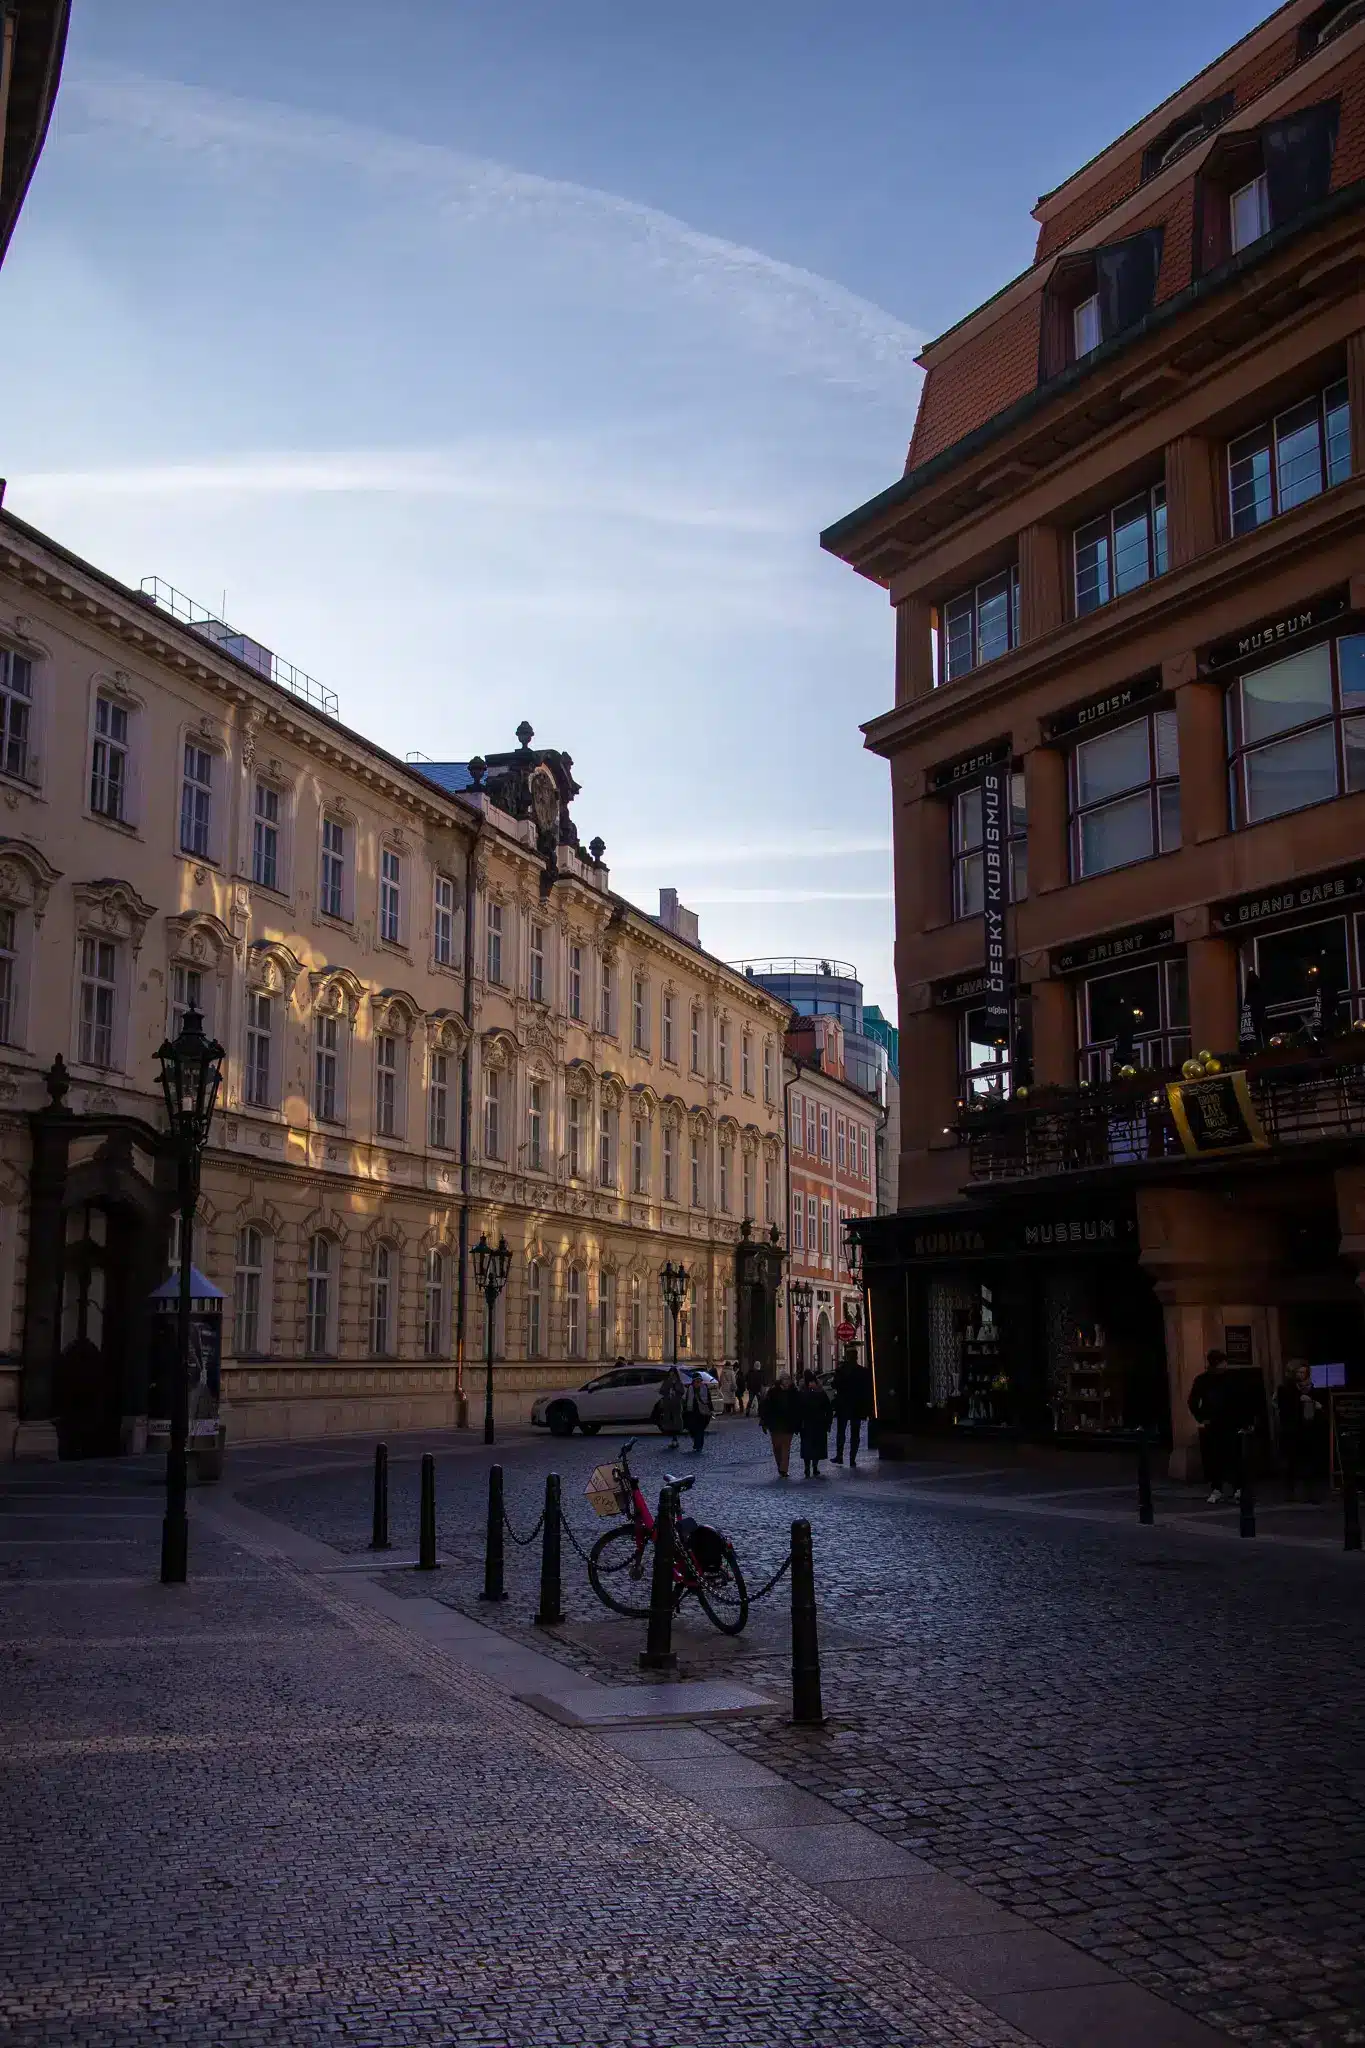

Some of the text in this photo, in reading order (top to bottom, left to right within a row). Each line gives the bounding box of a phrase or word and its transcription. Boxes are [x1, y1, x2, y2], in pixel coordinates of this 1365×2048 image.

[1238, 611, 1313, 655] MUSEUM
[1077, 690, 1132, 724] CUBISM
[952, 751, 994, 778] CZECH
[985, 775, 1004, 993] ČESKÝ KUBISMUS
[1238, 879, 1345, 921] GRAND CAFE
[1025, 1219, 1117, 1245] MUSEUM
